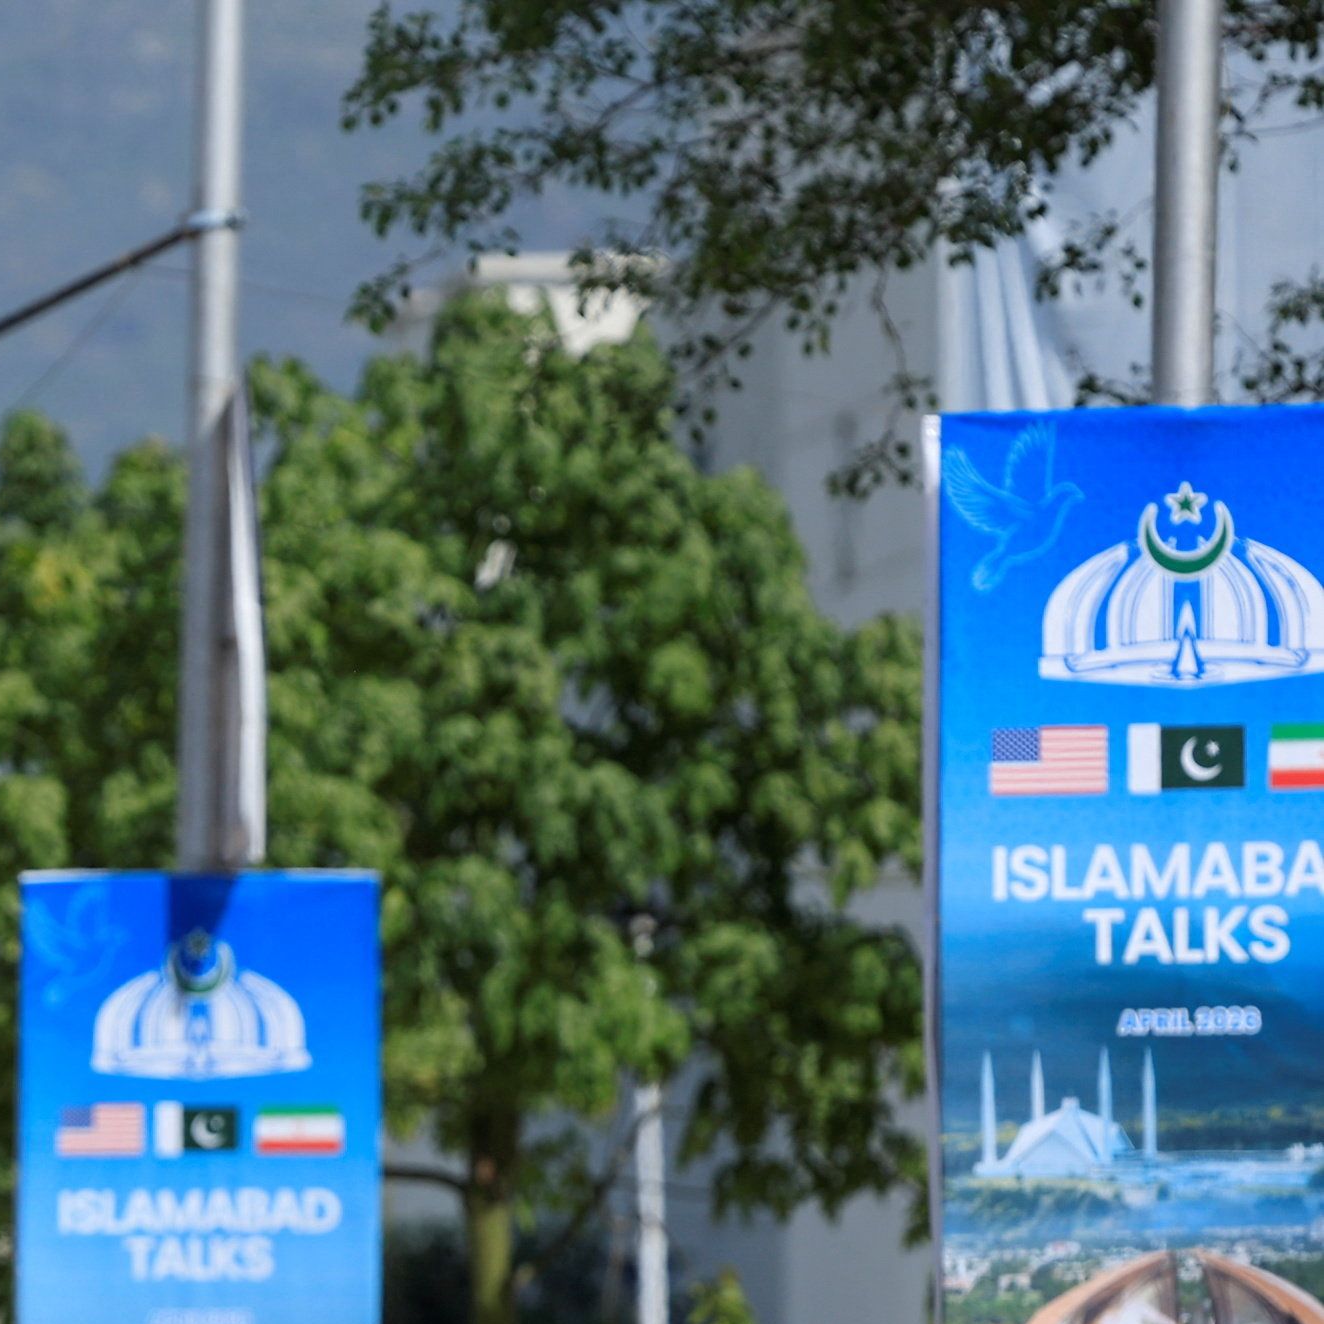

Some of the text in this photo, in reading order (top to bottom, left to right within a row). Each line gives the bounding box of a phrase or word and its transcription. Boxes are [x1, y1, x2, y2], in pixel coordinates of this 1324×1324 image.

[992, 839, 1324, 901] ISLAMABA
[1082, 905, 1291, 965] TALKS
[1116, 1007, 1194, 1037] APRIL
[58, 1187, 342, 1234] ISLAMABAD
[123, 1235, 275, 1281] TALKS
